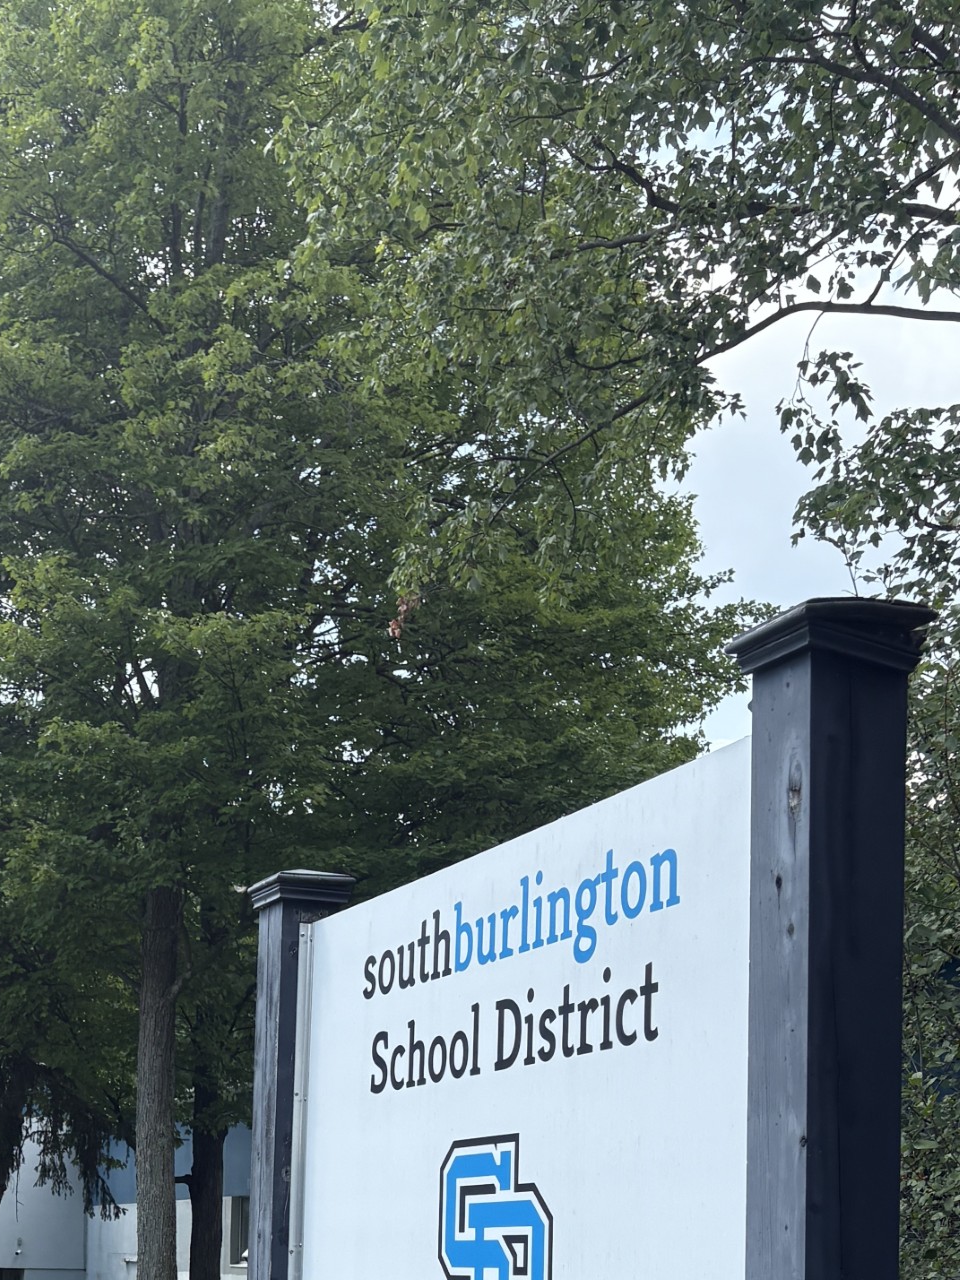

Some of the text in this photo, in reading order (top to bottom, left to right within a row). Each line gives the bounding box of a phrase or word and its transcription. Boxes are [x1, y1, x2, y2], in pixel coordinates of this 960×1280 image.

[362, 848, 681, 1000] southburlington
[370, 961, 659, 1094] School District
